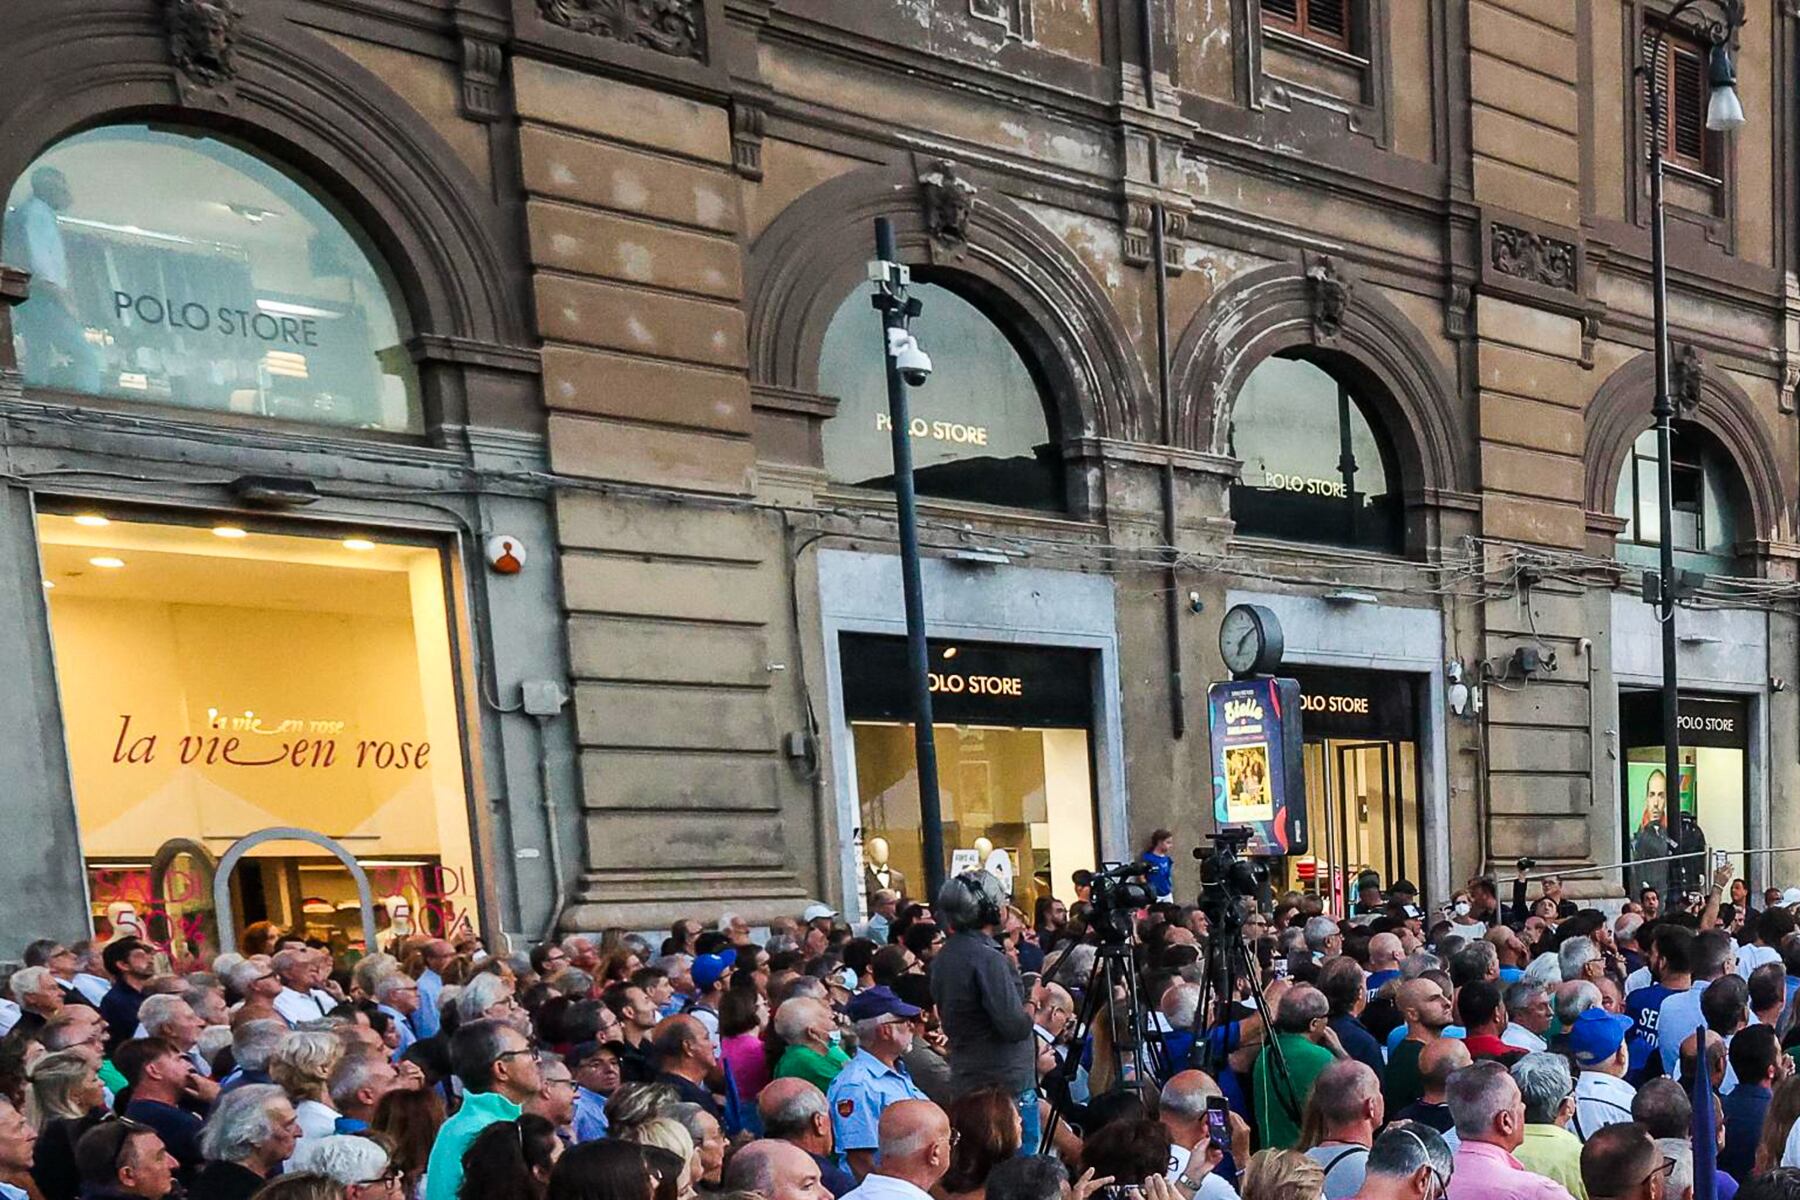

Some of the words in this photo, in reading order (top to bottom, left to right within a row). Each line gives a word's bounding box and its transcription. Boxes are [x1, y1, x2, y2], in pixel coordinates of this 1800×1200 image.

[114, 291, 210, 331] POLO
[218, 308, 318, 347] STORE
[933, 421, 988, 446] STORE
[1265, 472, 1303, 492] POLO
[1307, 478, 1347, 498] STORE
[928, 673, 964, 692] OLO
[968, 675, 1022, 696] STORE
[1299, 694, 1326, 711] OLO
[1328, 696, 1369, 713] STORE
[1677, 716, 1703, 729] POLO
[1705, 718, 1734, 731] STORE
[112, 715, 157, 764] la
[179, 722, 289, 766] vie
[290, 738, 335, 767] en
[356, 741, 431, 769] rose
[373, 865, 467, 898] SALDI
